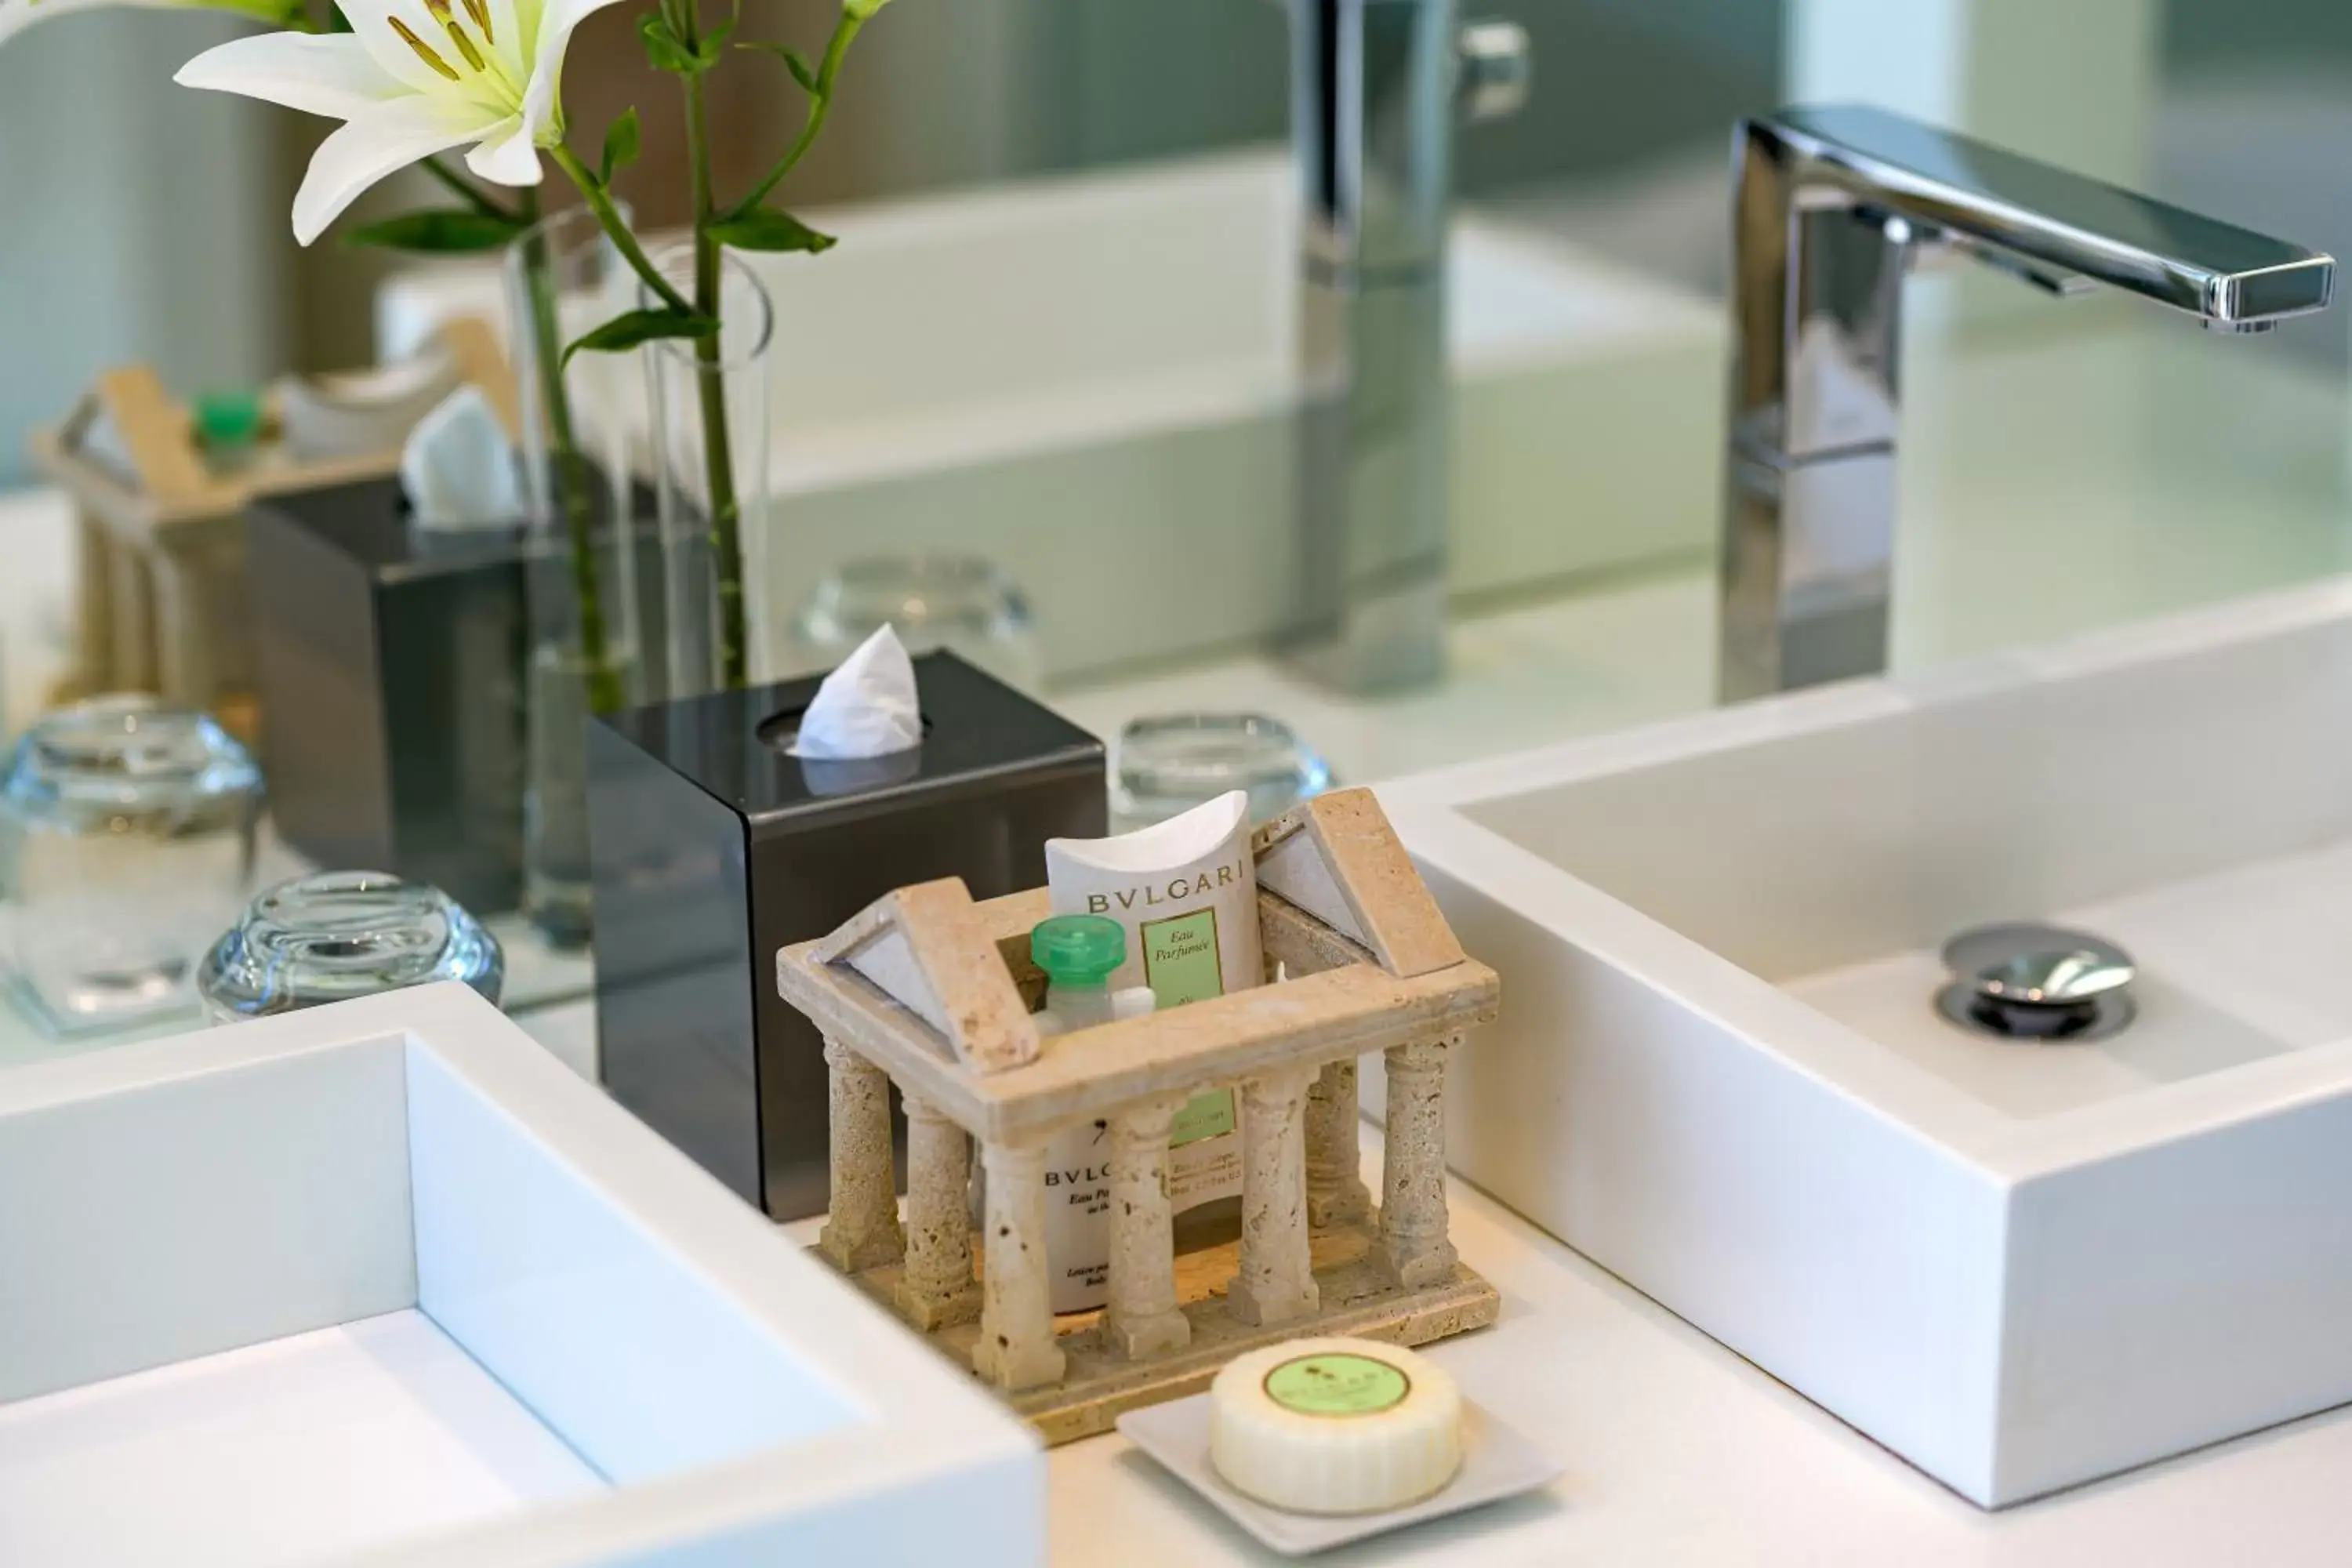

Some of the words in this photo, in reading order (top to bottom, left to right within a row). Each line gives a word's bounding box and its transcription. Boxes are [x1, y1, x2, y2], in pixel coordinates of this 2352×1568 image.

[1087, 859, 1243, 914] BVLGARI
[1171, 930, 1194, 944] Eau
[1069, 1194, 1093, 1205] Eau
